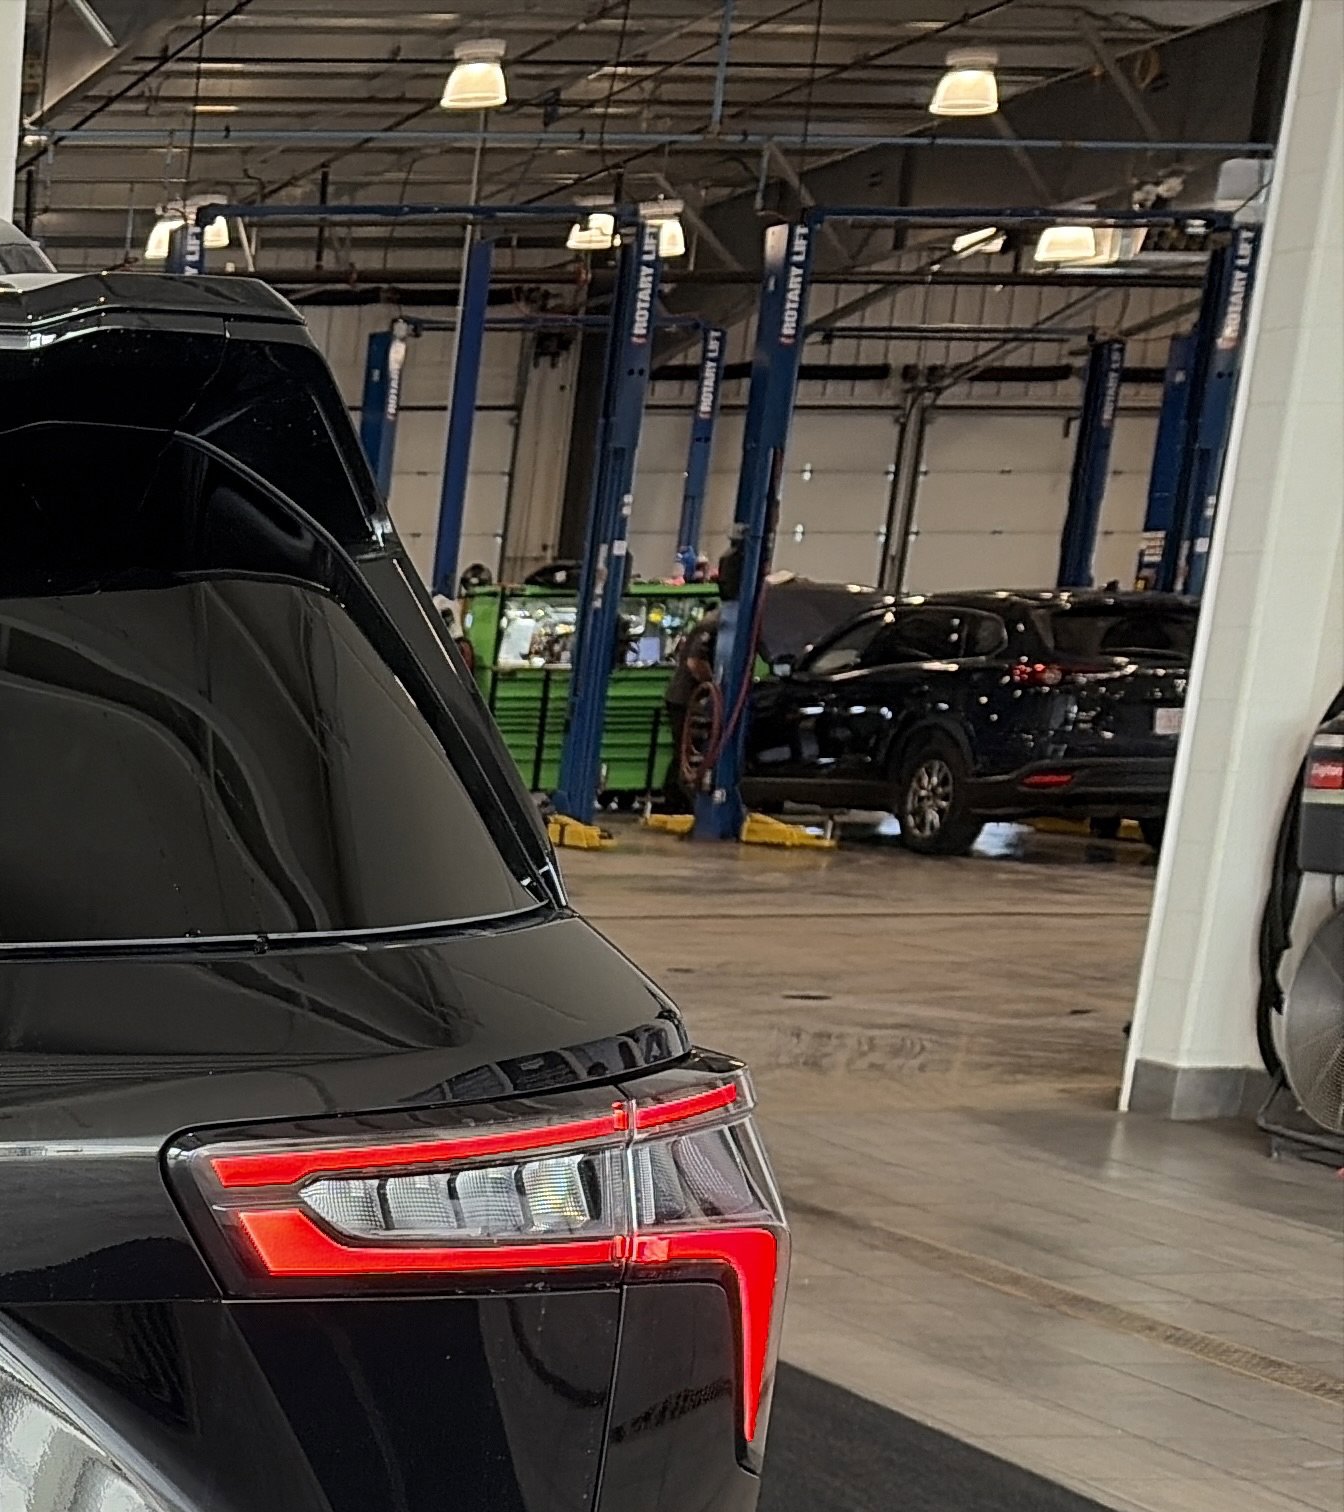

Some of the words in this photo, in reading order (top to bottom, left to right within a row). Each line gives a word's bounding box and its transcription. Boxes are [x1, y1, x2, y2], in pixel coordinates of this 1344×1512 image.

[642, 225, 658, 261] LIFT
[789, 224, 809, 262] LIFT
[1234, 228, 1255, 266] LIFT
[632, 265, 655, 335] ROTARY
[781, 265, 804, 335] ROTARY
[1222, 269, 1249, 339] ROTARY
[706, 330, 722, 358] LIFT
[699, 360, 717, 412] ROTARY
